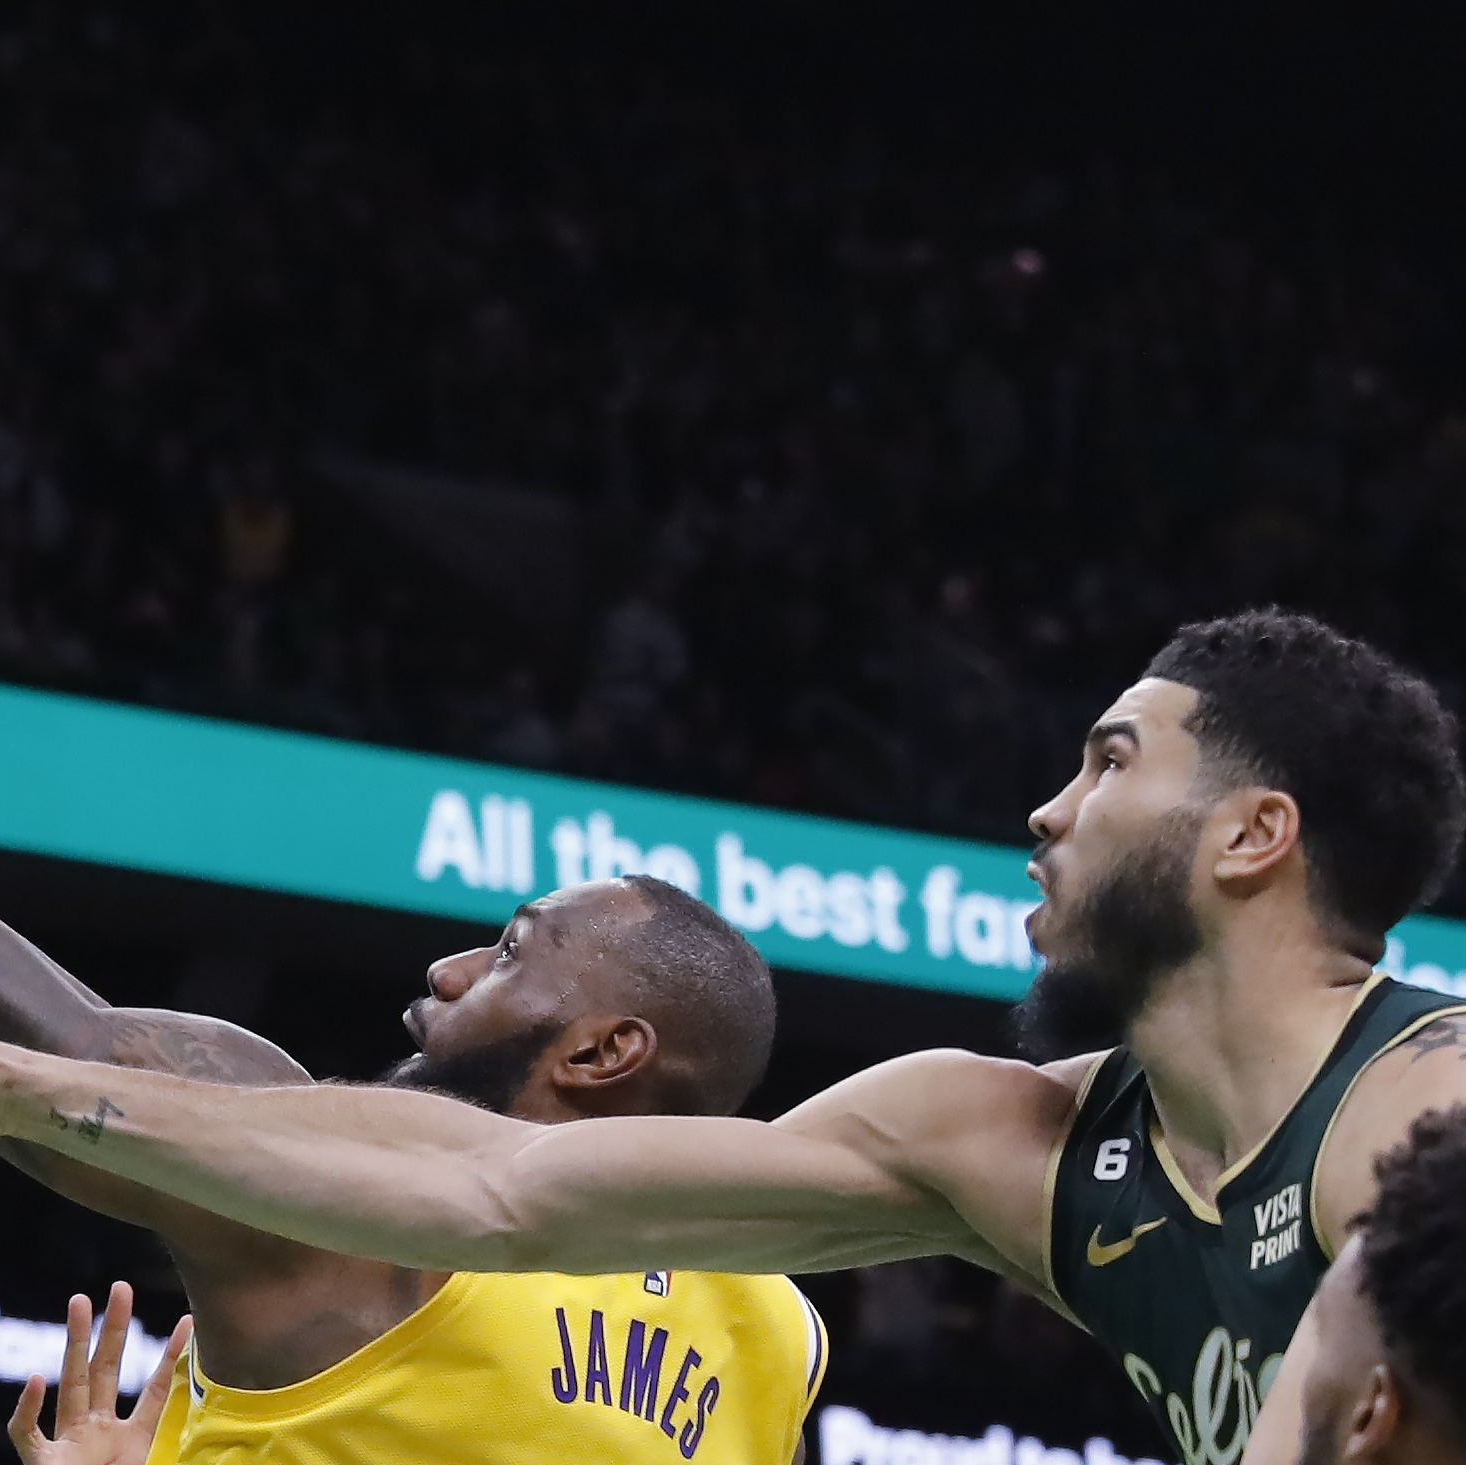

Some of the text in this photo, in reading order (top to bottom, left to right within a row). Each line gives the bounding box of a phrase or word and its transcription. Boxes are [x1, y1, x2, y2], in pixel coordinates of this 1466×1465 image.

[416, 789, 534, 894] All
[716, 833, 909, 953] best
[1093, 1137, 1132, 1181] 6
[1253, 1182, 1303, 1237] VISTA
[1250, 1219, 1302, 1271] PRINT
[551, 1307, 720, 1459] JAMES
